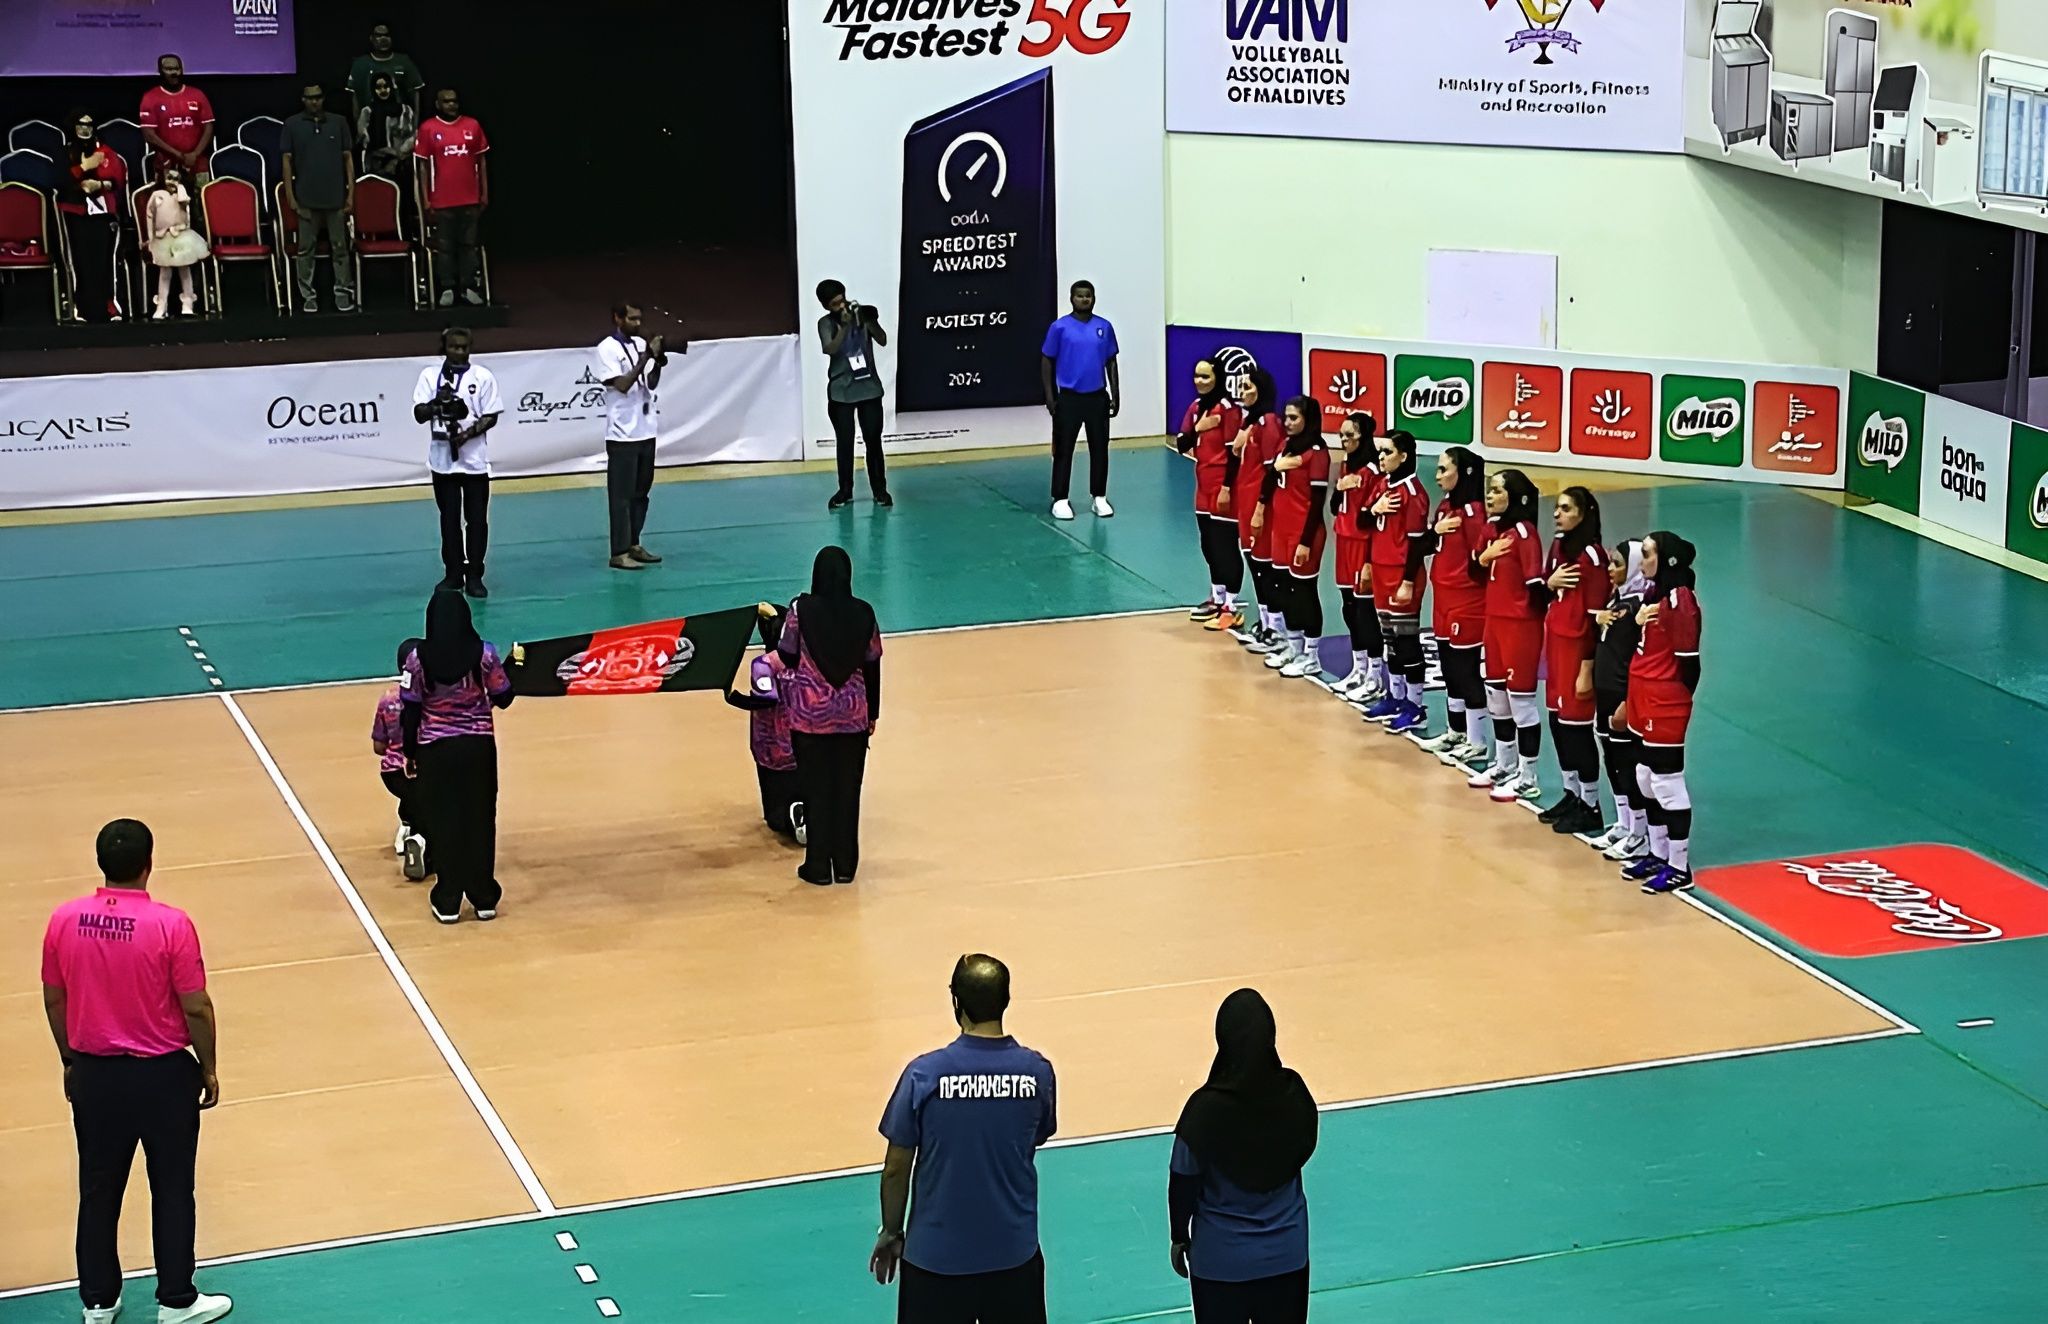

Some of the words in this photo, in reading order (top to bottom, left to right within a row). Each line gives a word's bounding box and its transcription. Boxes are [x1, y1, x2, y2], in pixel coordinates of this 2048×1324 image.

[823, 0, 1021, 23] Maldives
[1018, 0, 1131, 58] 5G
[832, 20, 1010, 61] Fastest
[1232, 45, 1343, 64] VOLLEYBALL
[1226, 66, 1350, 85] ASSOCIATION
[1438, 78, 1503, 95] Ministry
[1507, 79, 1526, 94] of
[1529, 80, 1588, 97] Sports,
[1592, 81, 1650, 96] Fitness
[1480, 99, 1512, 112] and
[1516, 100, 1606, 114] Recreation
[922, 232, 1018, 255] SPEEDTEST
[933, 253, 1007, 272] AWARDS
[925, 313, 985, 330] FASTEST
[1409, 387, 1465, 409] MILO
[267, 395, 379, 429] Ocean
[1676, 409, 1734, 430] MILO
[1864, 427, 1904, 458] MILO
[1940, 468, 1987, 502] aqua
